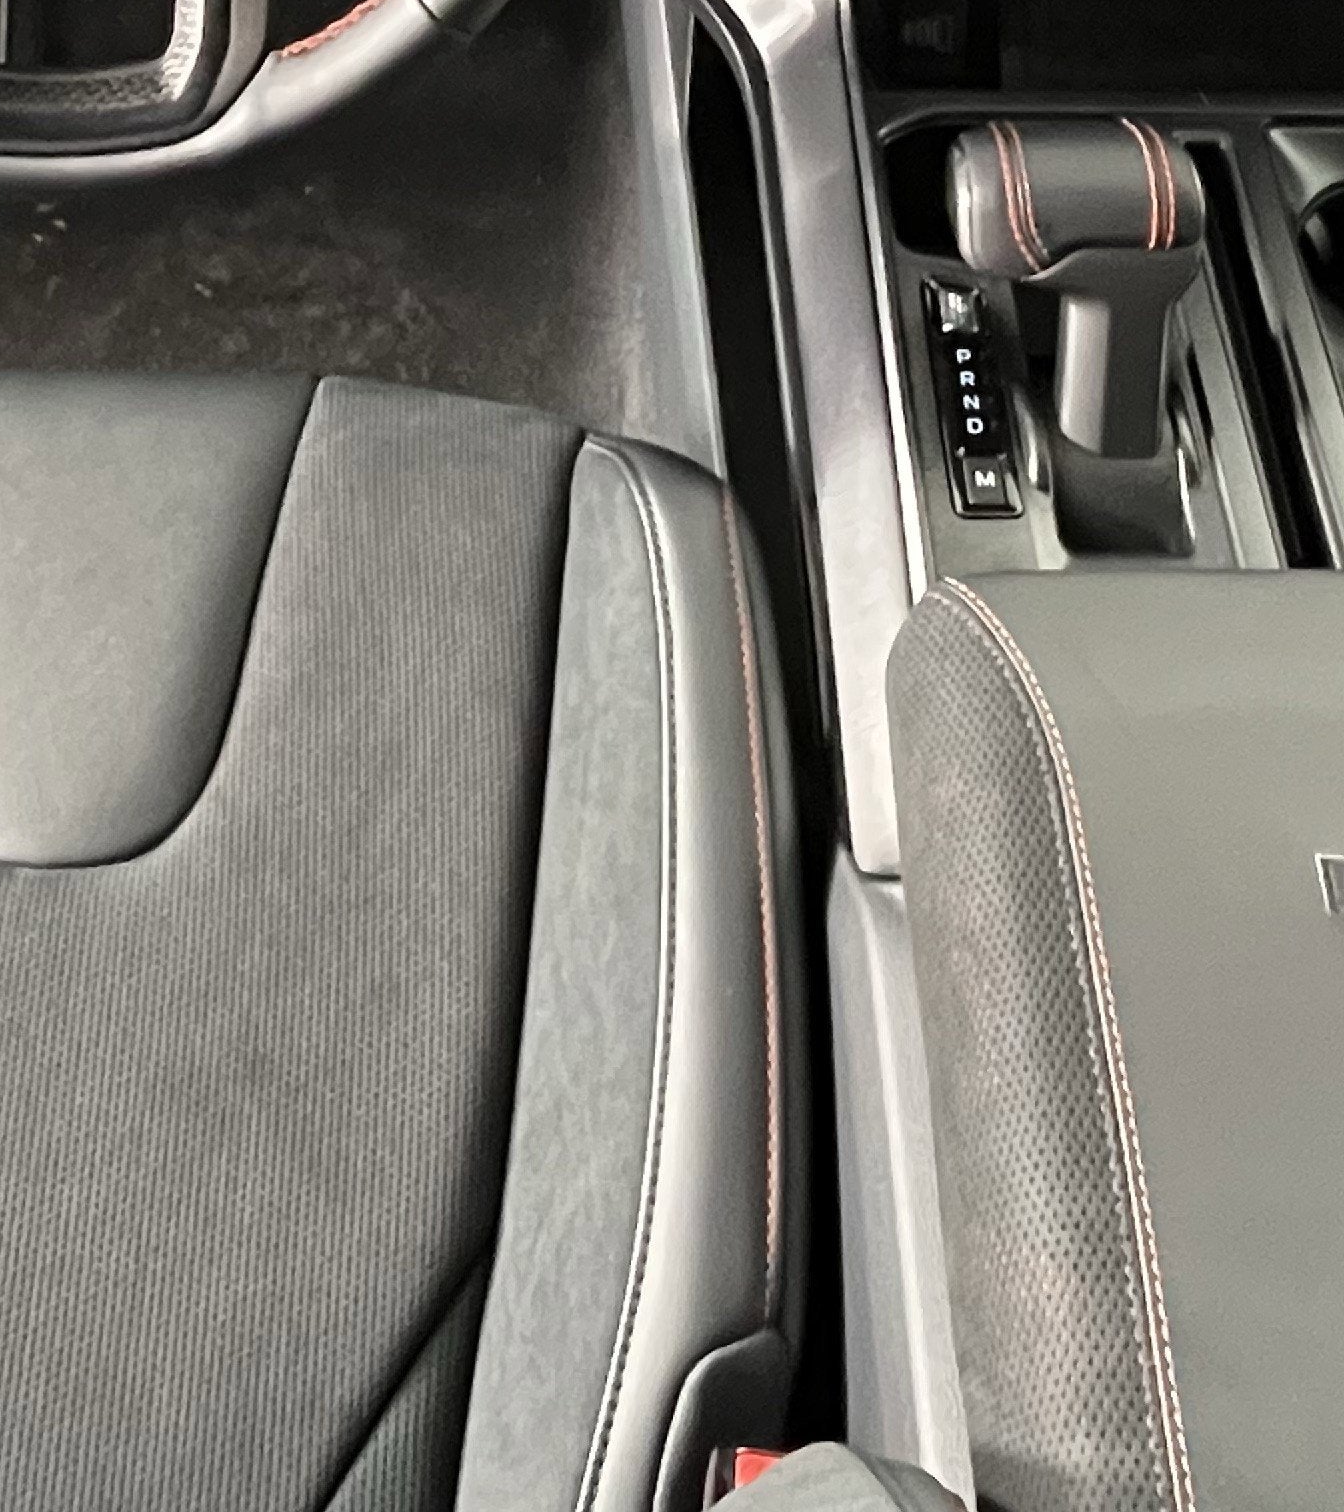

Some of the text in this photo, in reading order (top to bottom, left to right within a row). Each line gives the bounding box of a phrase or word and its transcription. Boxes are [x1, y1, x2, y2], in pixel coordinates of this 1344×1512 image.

[956, 348, 972, 364] P
[959, 370, 976, 387] R
[962, 394, 981, 411] N
[966, 417, 985, 435] D
[973, 469, 997, 488] M
